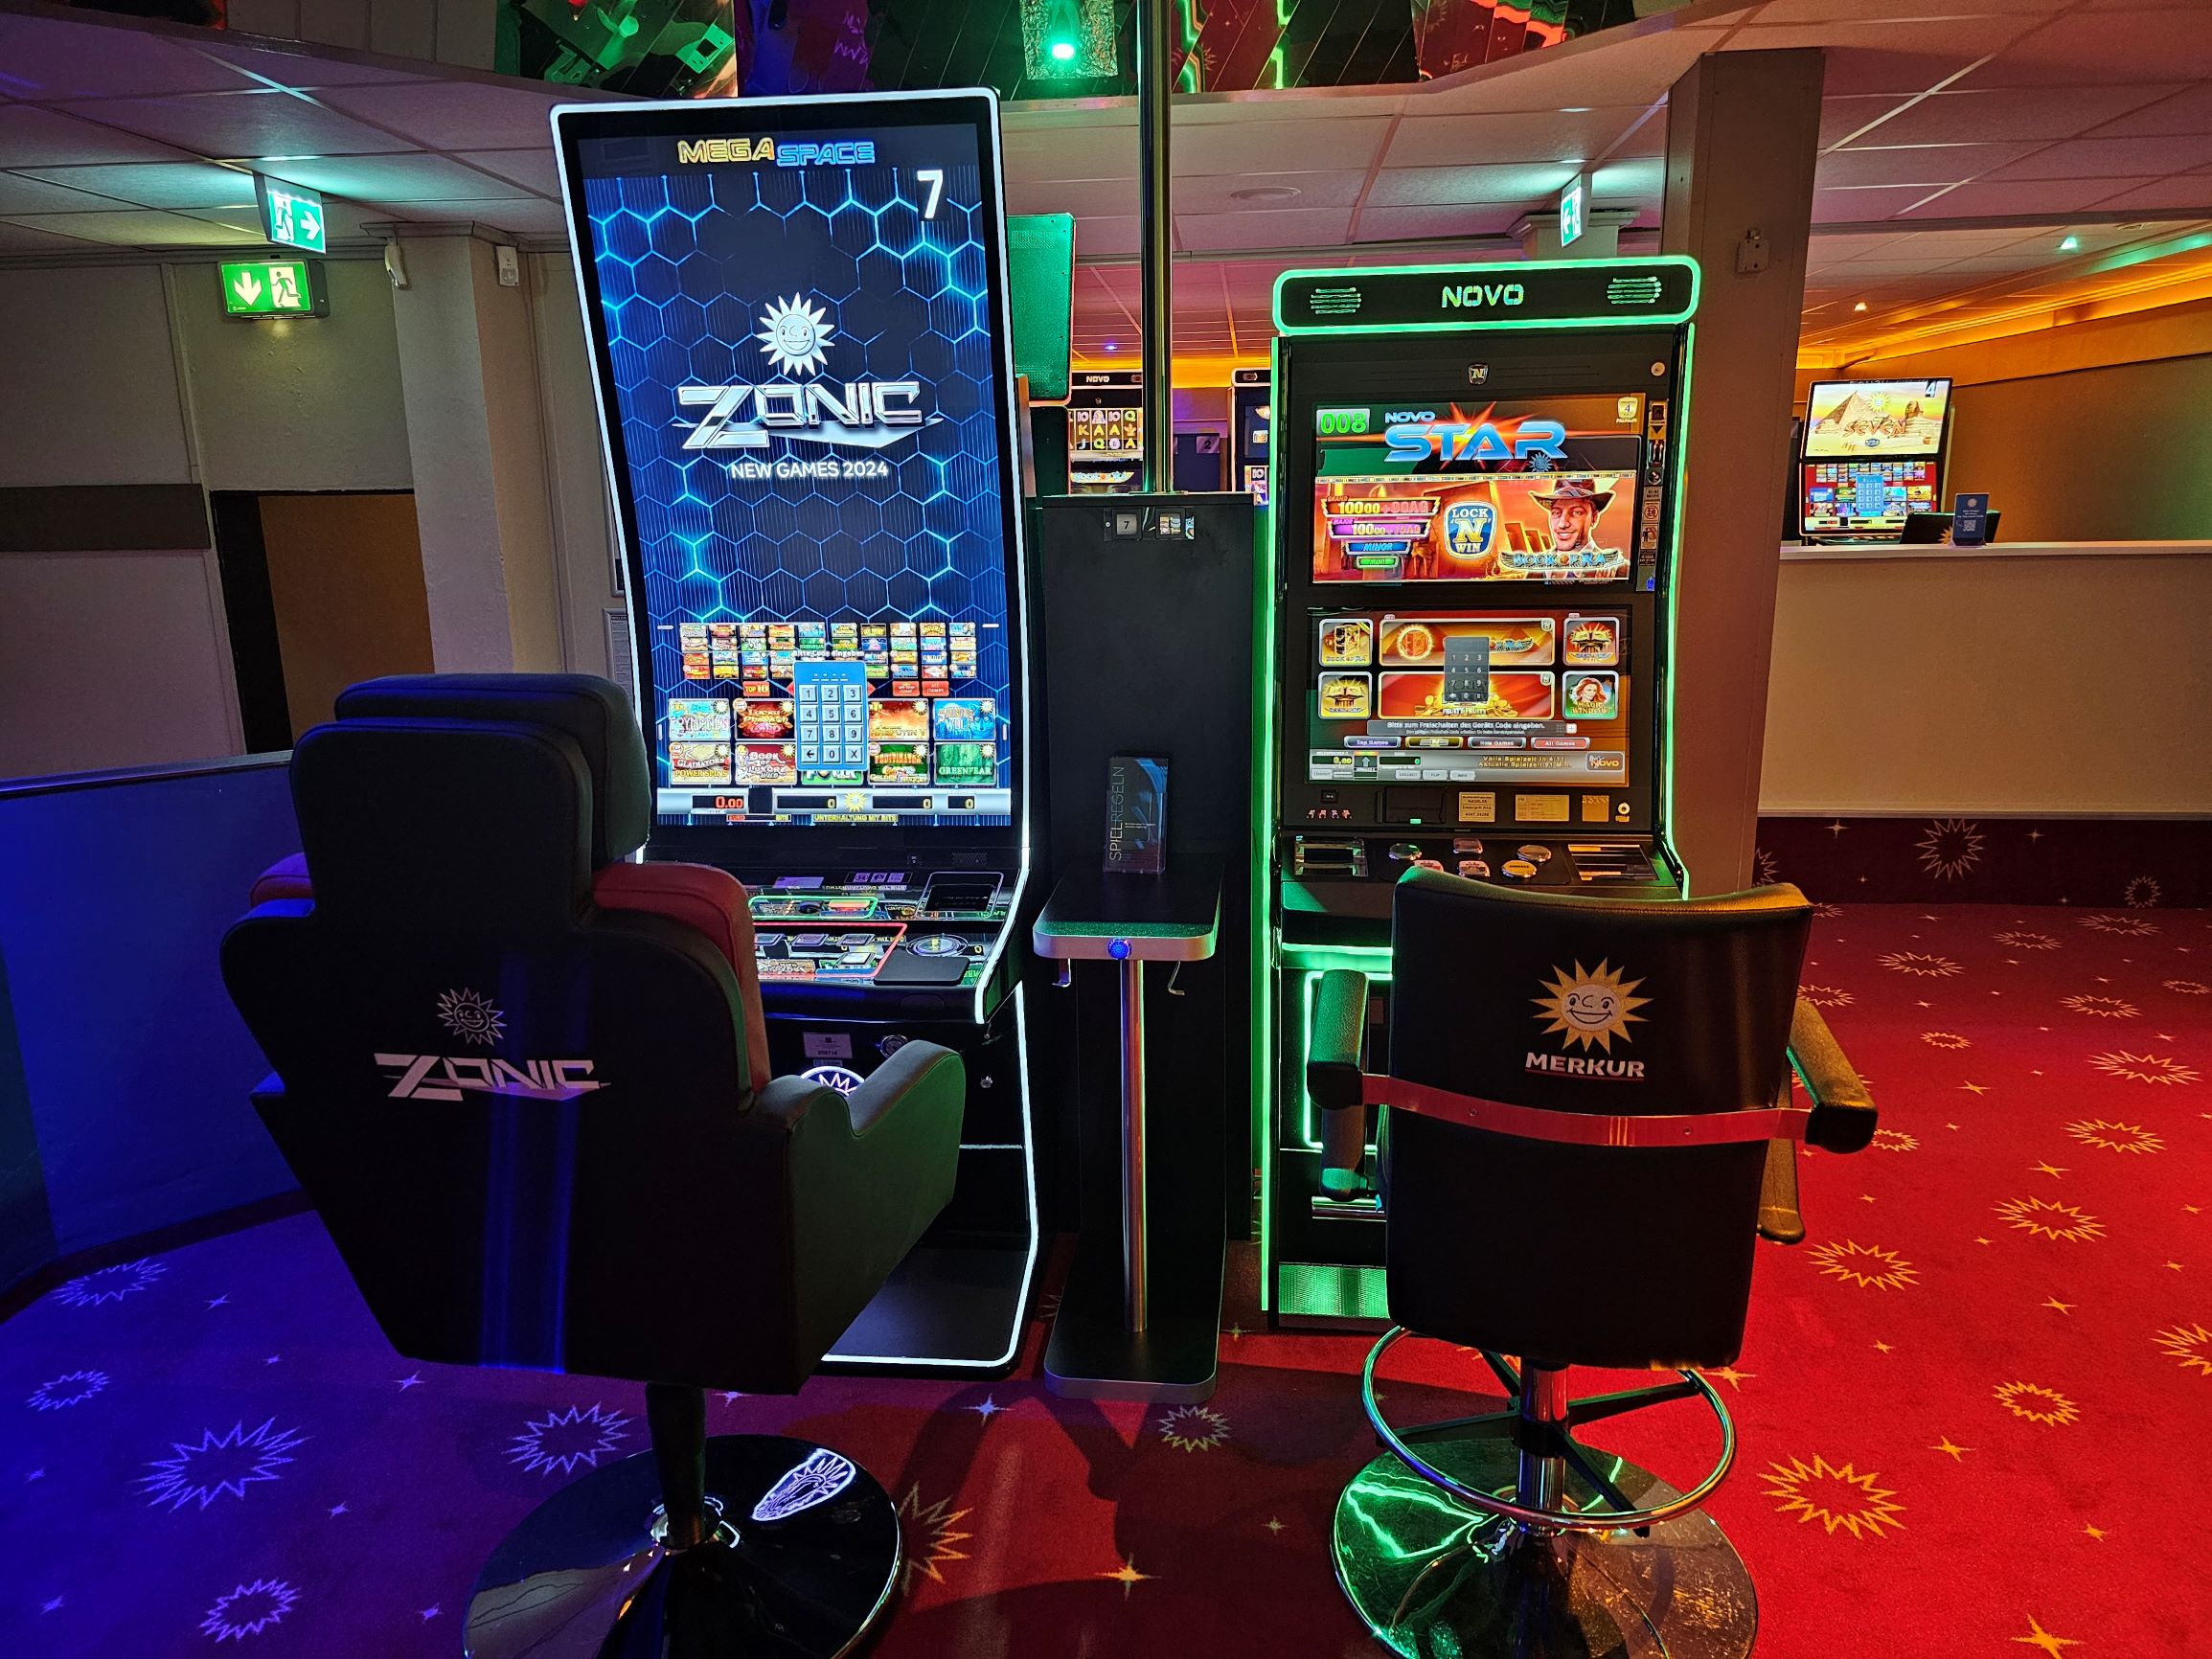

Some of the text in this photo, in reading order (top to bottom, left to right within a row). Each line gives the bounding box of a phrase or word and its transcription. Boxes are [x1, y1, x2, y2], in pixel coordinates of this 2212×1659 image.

[677, 137, 876, 168] MEGA SPACE
[916, 170, 944, 219] 7
[1441, 284, 1524, 308] NOVO
[1085, 375, 1110, 383] NOVO
[1926, 381, 1936, 398] 4
[677, 381, 923, 449] ZONIC
[1384, 411, 1436, 423] NOVO
[1321, 413, 1367, 434] 008
[1843, 416, 1907, 437] SEVEN
[1203, 441, 1212, 449] 2
[1383, 421, 1568, 463] STAR
[731, 461, 890, 479] NEW GAMES 2024
[1451, 508, 1489, 518] LOCK
[1123, 520, 1129, 529] 7
[1362, 542, 1394, 553] MINOR
[1454, 542, 1482, 553] WIN
[1514, 554, 1555, 567] BOOK
[828, 689, 833, 698] 2
[850, 689, 856, 698] 3
[806, 709, 856, 718] 4 5 6
[807, 729, 857, 739] 7 8 9
[829, 750, 835, 759] 0
[939, 766, 992, 775] GREENFEAR
[716, 796, 743, 809] 0.00
[827, 798, 835, 808] 0
[923, 798, 931, 808] 0
[965, 798, 974, 808] 0
[1524, 1052, 1645, 1078] MERKUR
[374, 1053, 601, 1102] ZONIC
